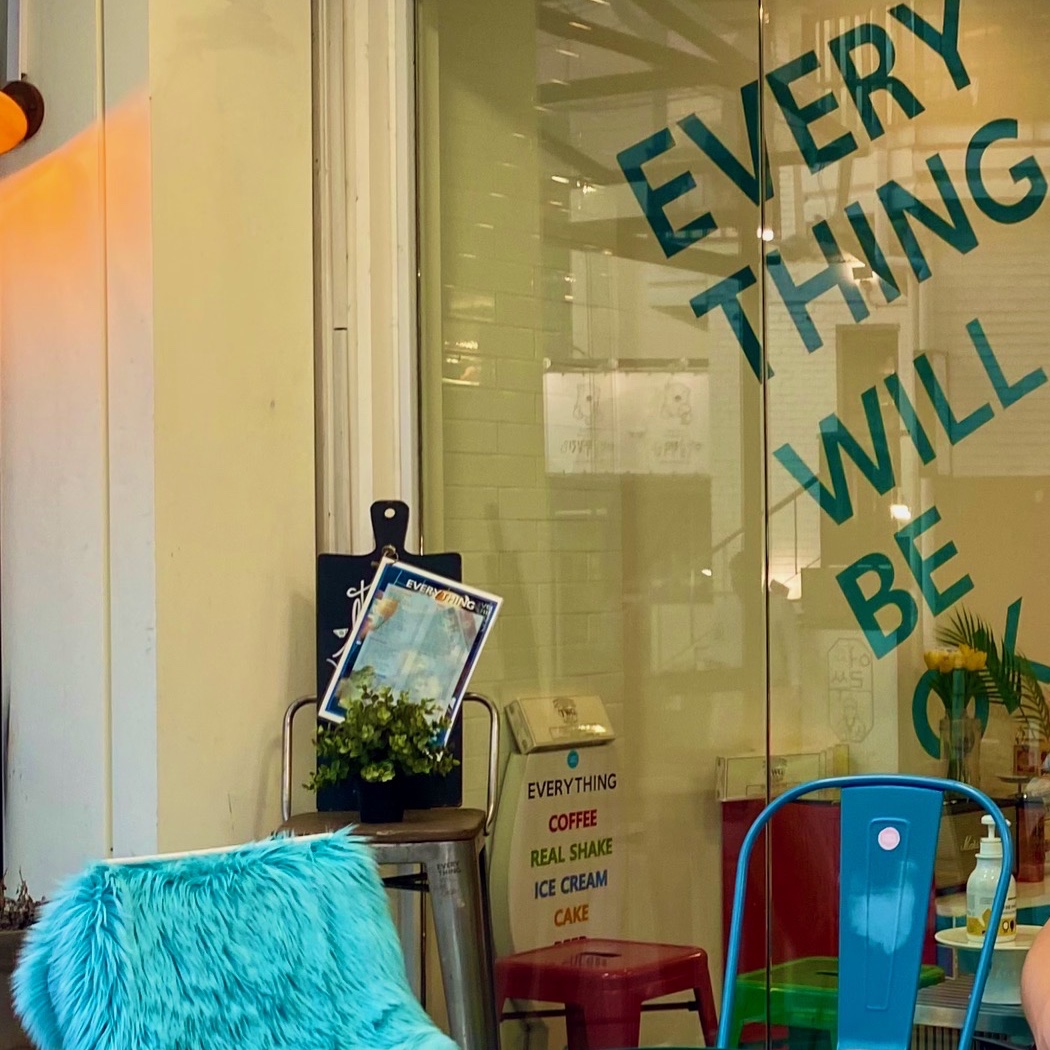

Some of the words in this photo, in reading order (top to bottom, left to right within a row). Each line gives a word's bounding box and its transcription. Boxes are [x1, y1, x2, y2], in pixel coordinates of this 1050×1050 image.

[616, 0, 970, 258] EVERY
[690, 118, 1048, 384] THING
[773, 318, 1048, 525] WILL
[405, 578, 475, 611] EVERYTHING
[835, 505, 975, 660] BE
[528, 773, 617, 799] EVERYTHING
[548, 809, 597, 832] COFFEE
[530, 846, 566, 868] REAL
[569, 837, 613, 861] SHAKE
[534, 878, 556, 900] ICE
[560, 868, 608, 894] CREAM
[553, 904, 589, 928] CAKE
